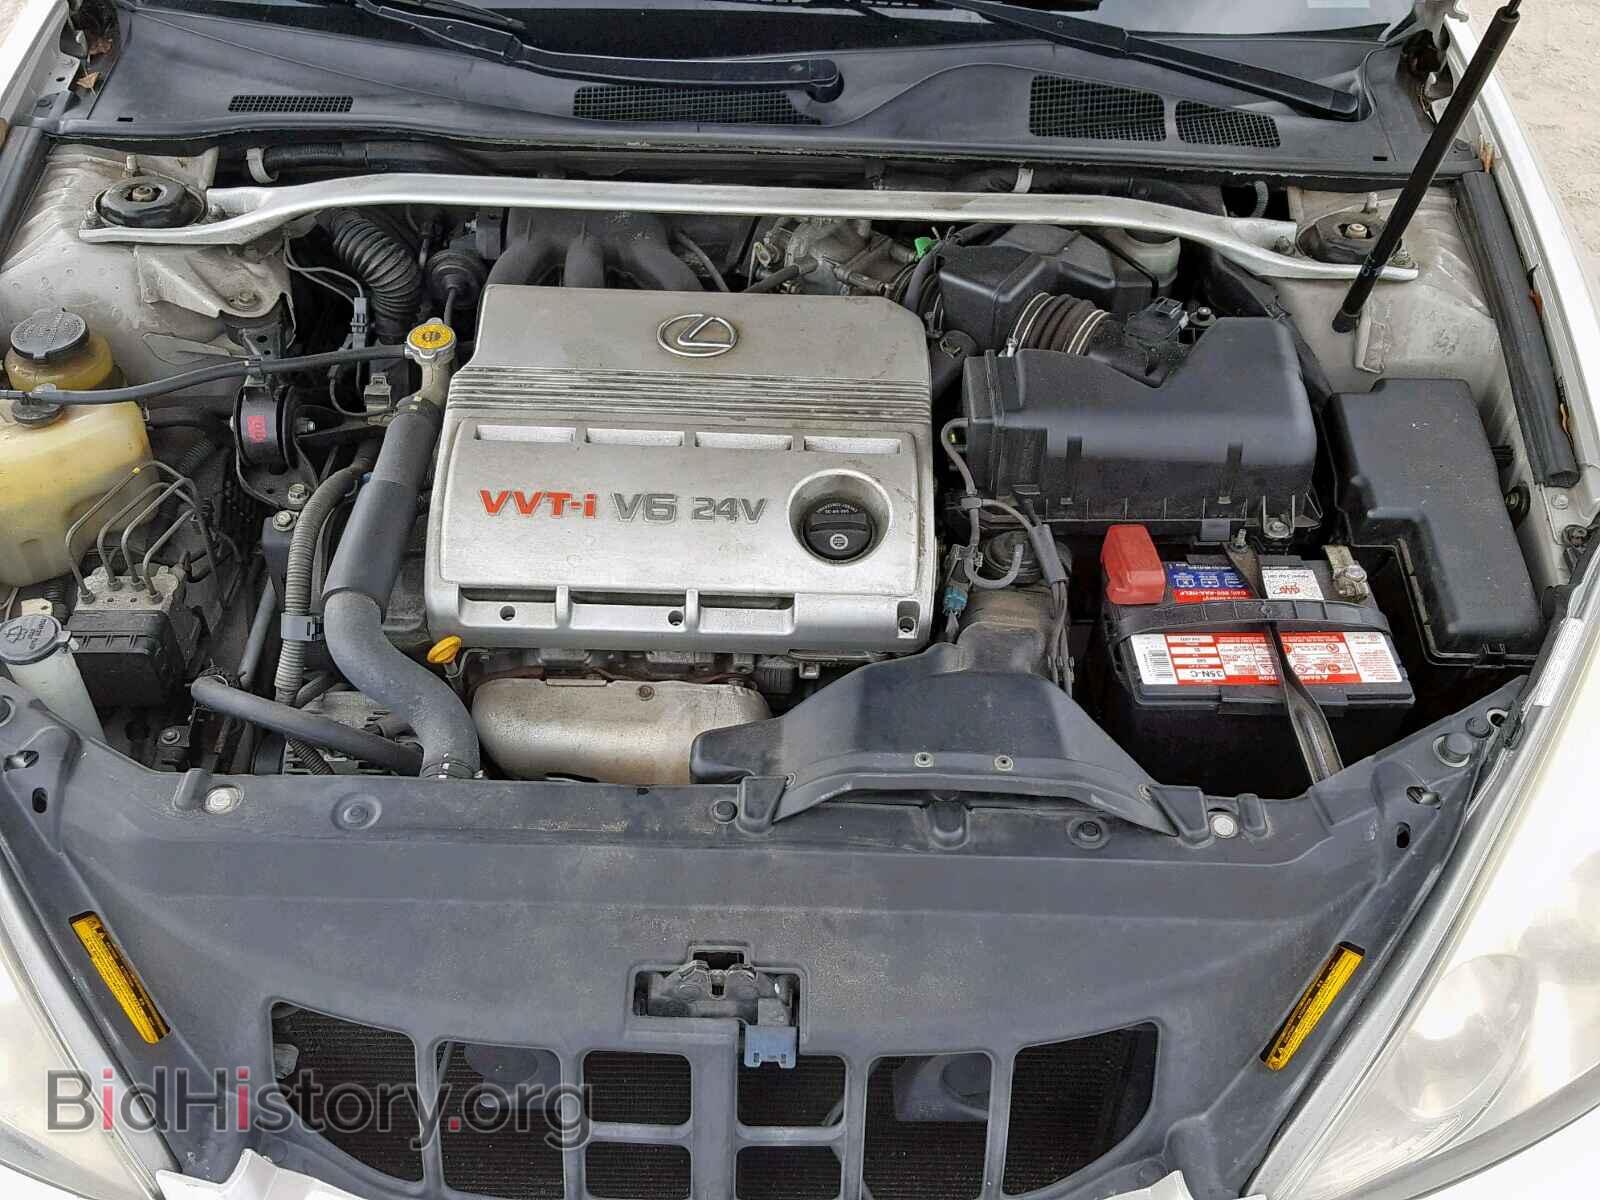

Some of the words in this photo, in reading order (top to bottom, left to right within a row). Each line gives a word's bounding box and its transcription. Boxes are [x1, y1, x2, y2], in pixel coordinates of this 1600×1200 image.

[479, 488, 598, 520] VVT-i
[610, 492, 678, 523] V6
[690, 496, 770, 525] 24V
[1189, 670, 1223, 678] 35N-C
